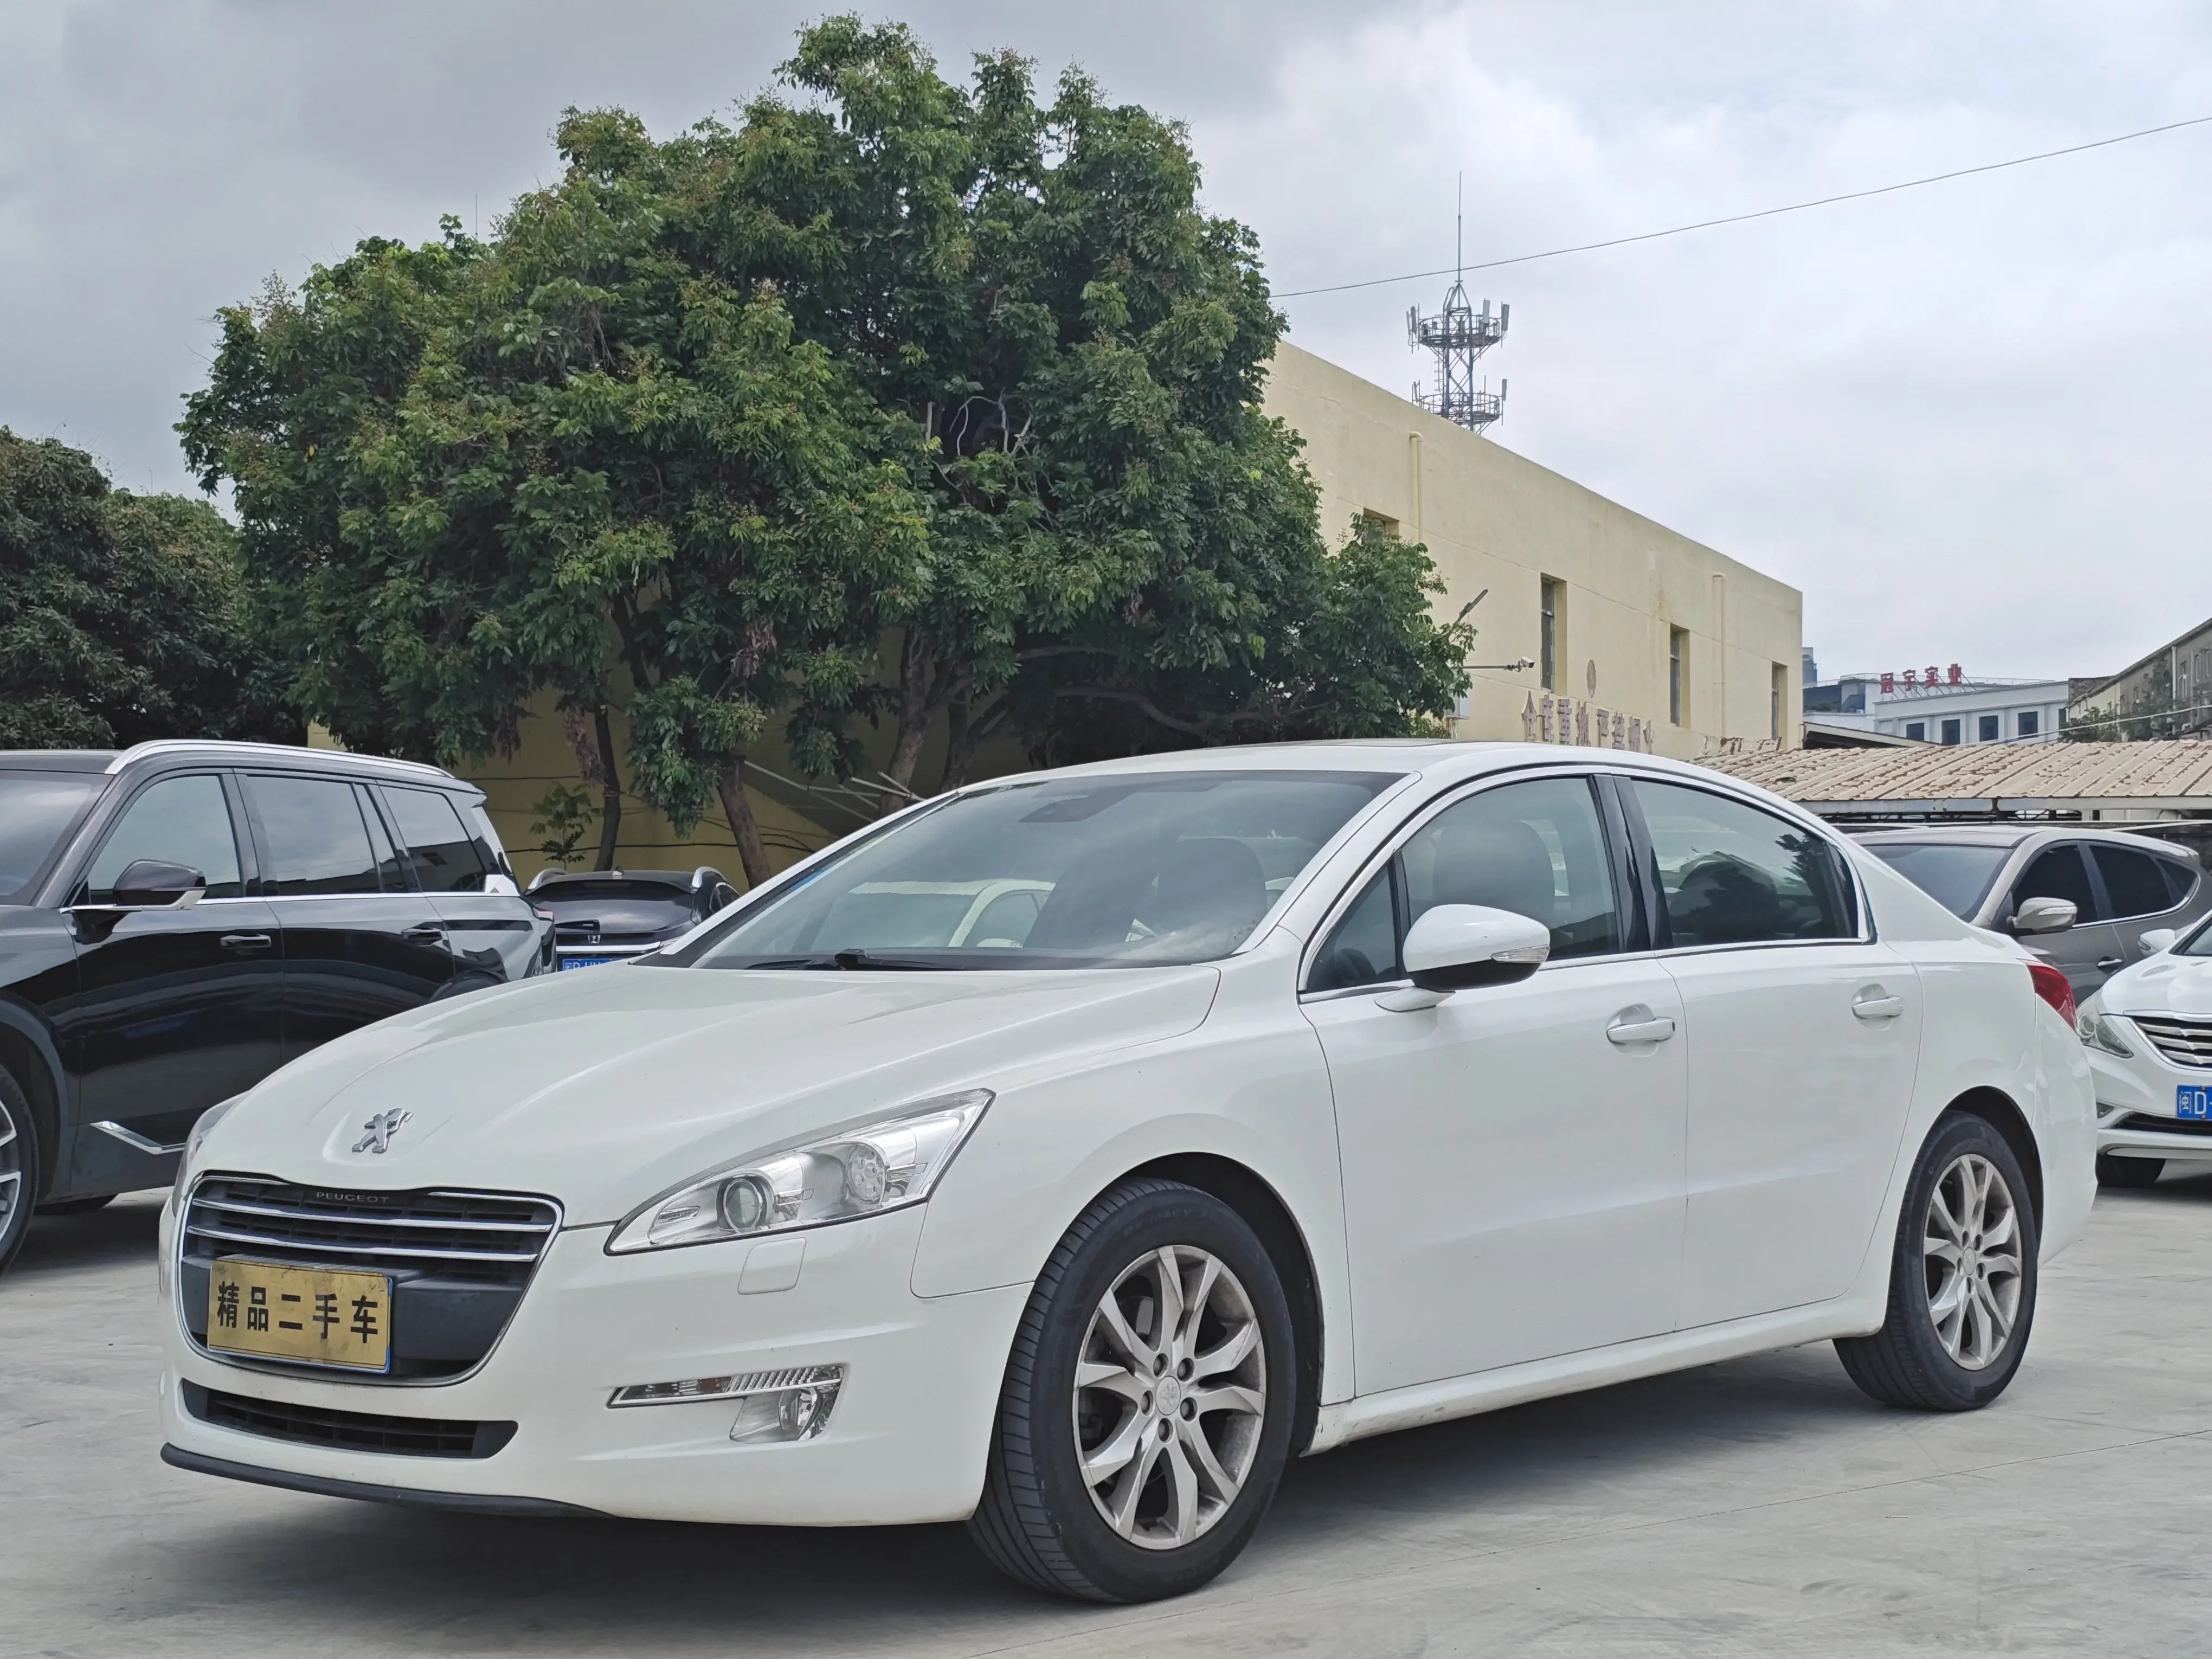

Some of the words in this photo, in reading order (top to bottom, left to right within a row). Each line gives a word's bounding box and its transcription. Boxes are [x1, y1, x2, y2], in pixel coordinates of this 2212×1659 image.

[316, 1191, 389, 1203] PEUGEOT
[217, 1281, 378, 1343] 精品二手车
